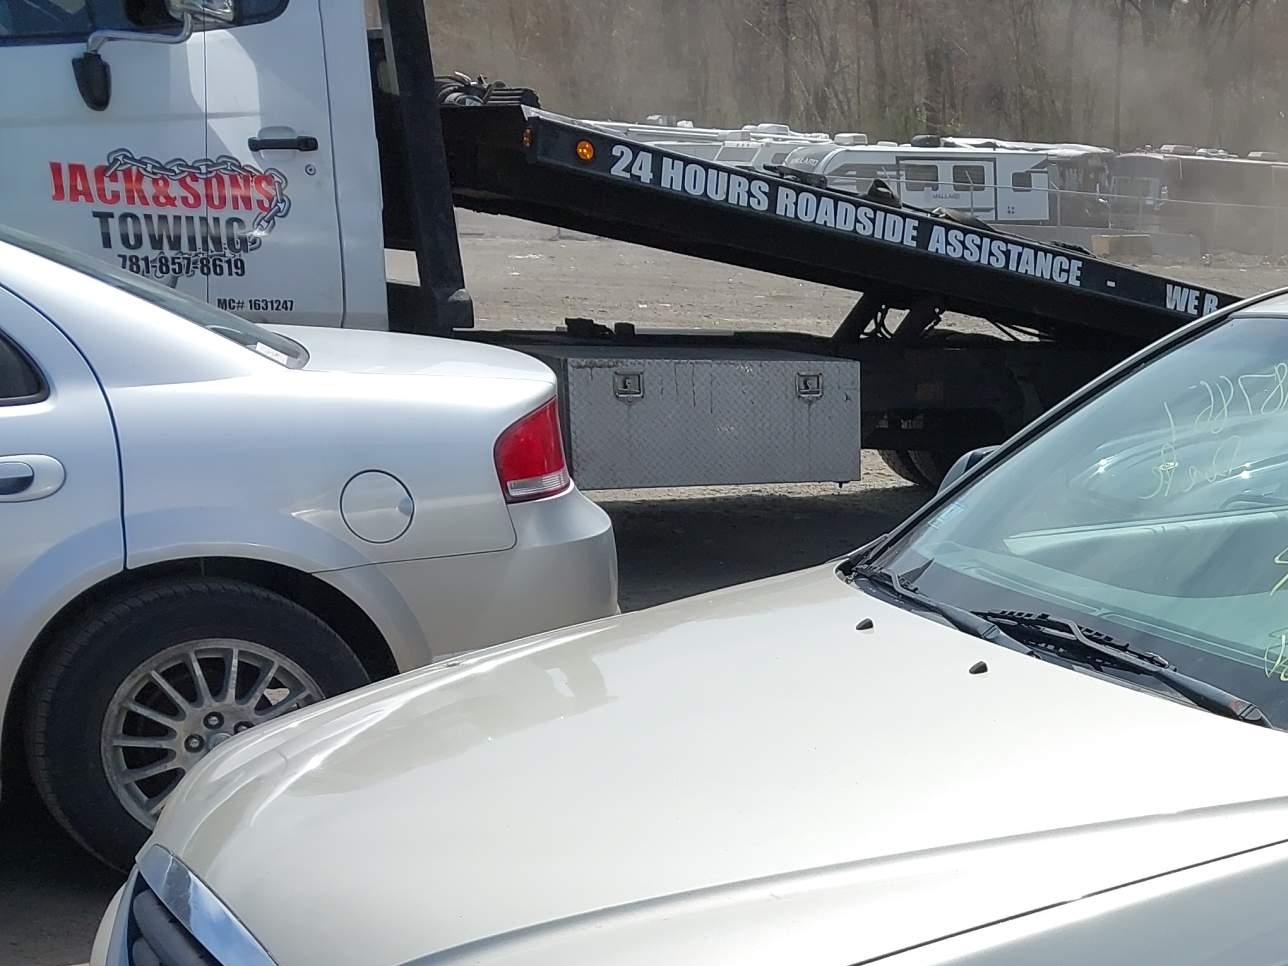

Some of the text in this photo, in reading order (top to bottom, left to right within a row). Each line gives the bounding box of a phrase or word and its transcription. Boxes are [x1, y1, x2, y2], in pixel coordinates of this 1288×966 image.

[49, 161, 276, 213] JACK&SONS
[92, 211, 252, 254] TOWING
[610, 144, 653, 184] 24
[660, 156, 769, 211] HOURS
[776, 186, 919, 247] ROADSIDE
[928, 226, 1083, 287] ASSISTANCE
[1166, 284, 1200, 315] WE
[117, 253, 246, 277] 781-857-8619
[217, 298, 294, 312] MC# 1631247
